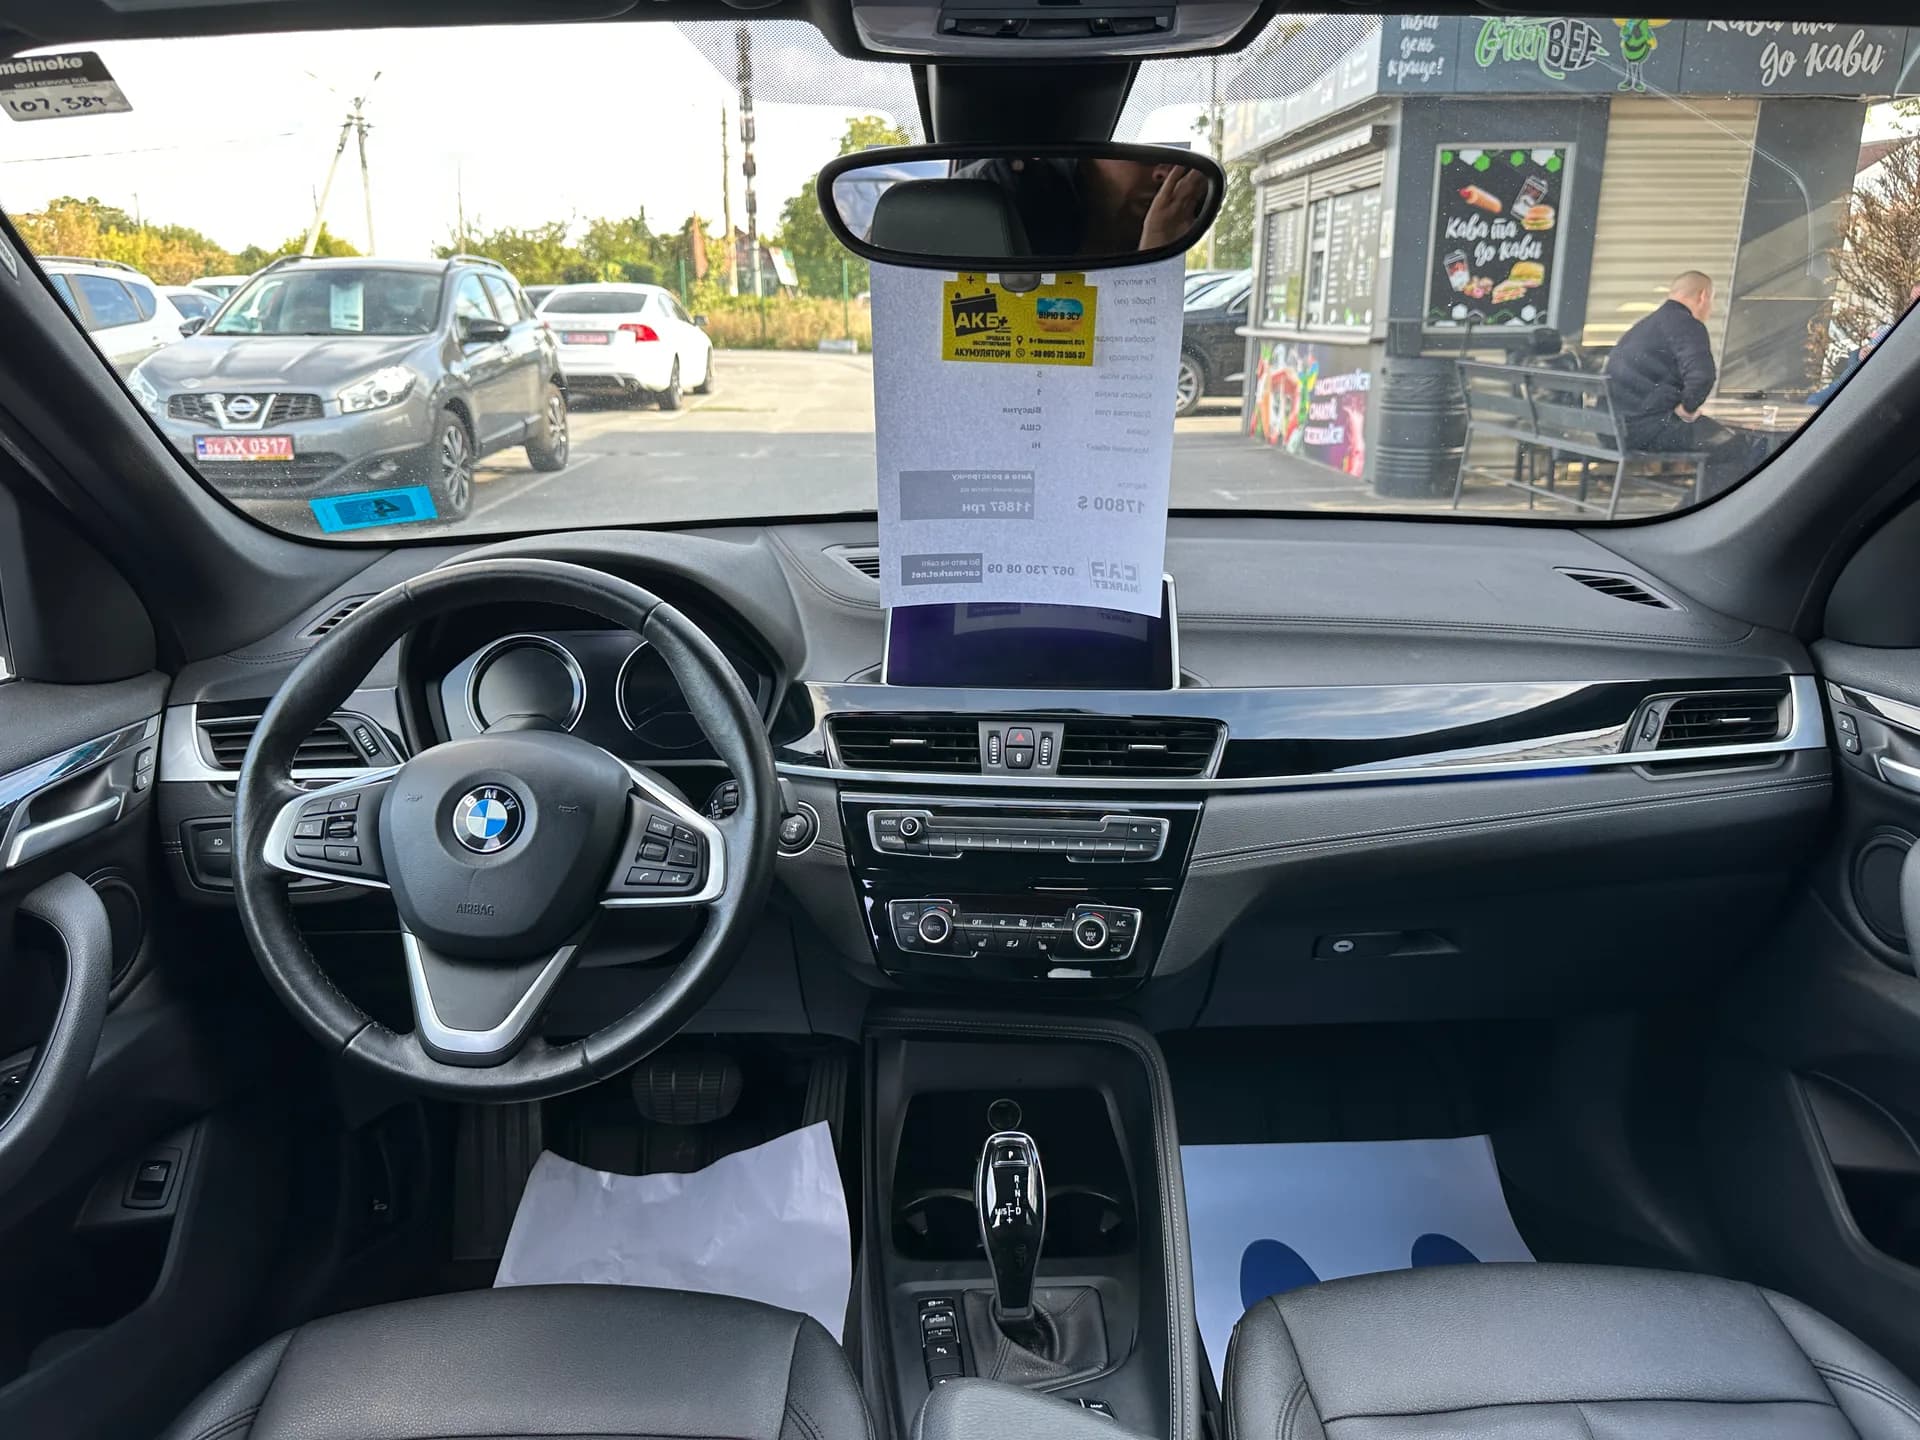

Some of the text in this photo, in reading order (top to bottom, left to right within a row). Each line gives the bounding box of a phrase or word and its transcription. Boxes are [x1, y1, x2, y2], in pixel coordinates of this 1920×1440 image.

[1400, 36, 1435, 59] день
[1760, 28, 1884, 87] до кави
[1387, 56, 1444, 84] краще!
[1445, 213, 1518, 241] Кава та
[1474, 233, 1543, 267] до кави
[954, 347, 1011, 359] АКУМУЛЯТОРИ
[249, 438, 288, 454] 0317
[463, 788, 518, 810] BMW
[881, 819, 897, 827] MODE
[455, 902, 495, 917] AIRBAG
[1041, 921, 1056, 929] SYNC
[1115, 919, 1127, 927] A/C
[1008, 1150, 1014, 1159] P
[1013, 1174, 1020, 1183] R
[1014, 1189, 1021, 1198] N
[1015, 1206, 1022, 1216] D
